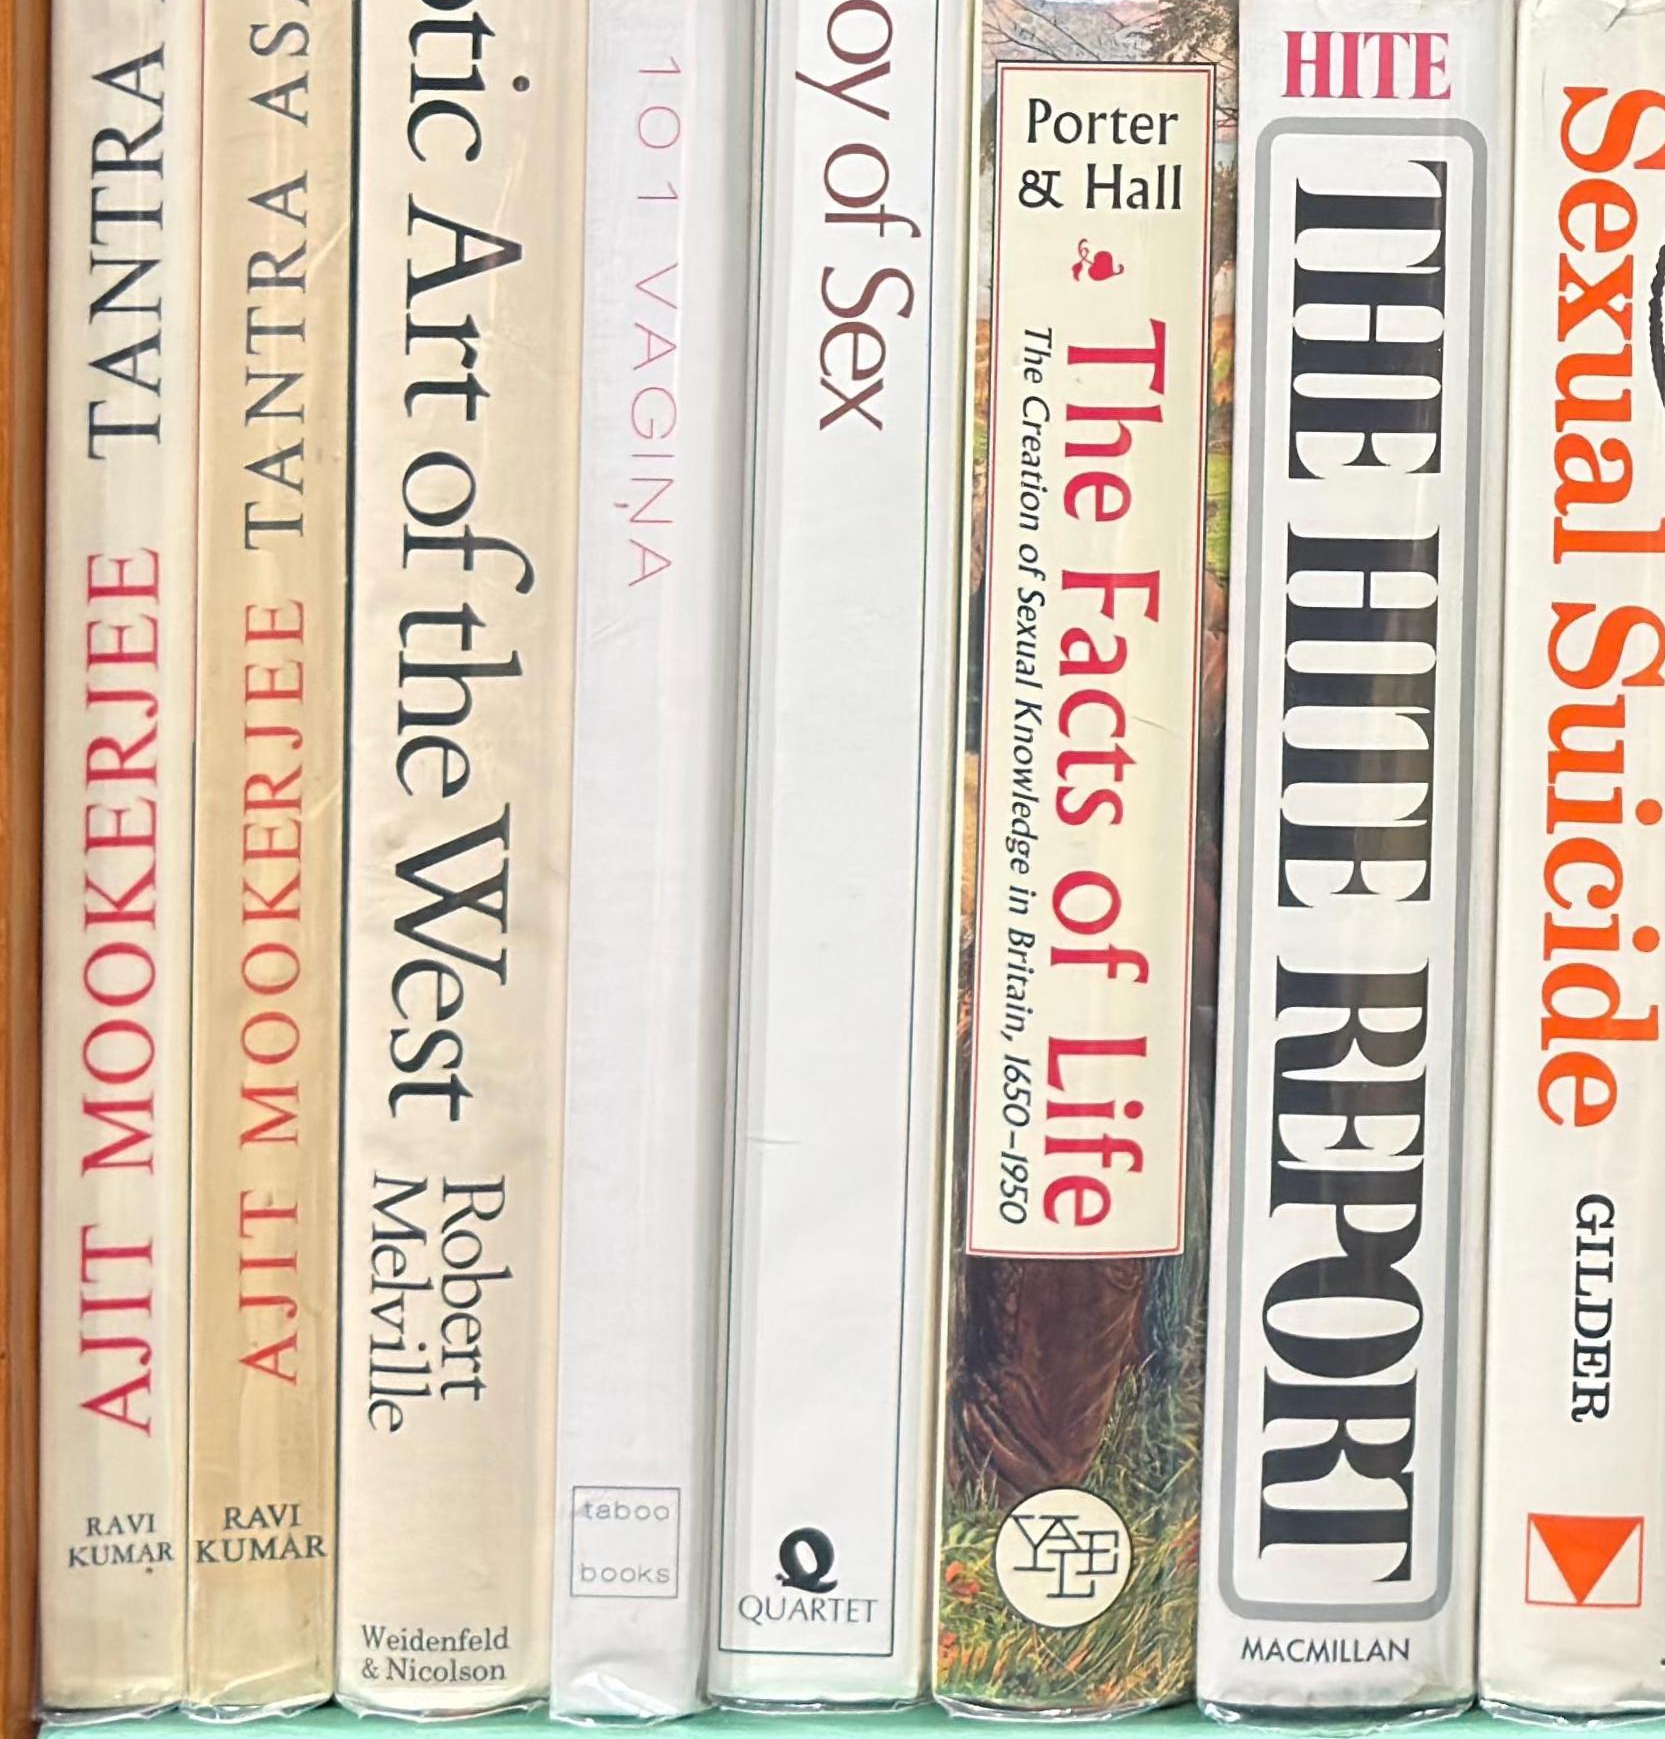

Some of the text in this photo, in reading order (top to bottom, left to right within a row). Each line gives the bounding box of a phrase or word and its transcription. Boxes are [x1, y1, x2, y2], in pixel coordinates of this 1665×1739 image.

[1026, 97, 1179, 146] Porter
[1280, 30, 1452, 100] HITE
[88, 42, 166, 459] TANTRA
[822, 142, 923, 240] of
[1018, 164, 1182, 210] & Hall
[404, 192, 523, 422] Art
[819, 265, 915, 432] Sex
[401, 450, 535, 595] of
[395, 602, 524, 798] the
[1001, 324, 1053, 1043] The Creation of Sexual Knowledge in Britain,
[1042, 317, 1167, 1228] The Facts of Life
[81, 546, 161, 1177] MOOKERJEE
[1257, 159, 1449, 1583] THE HITE REPORT
[387, 801, 513, 1123] West
[79, 1224, 154, 1438] AJIT
[366, 1175, 433, 1434] Melville
[440, 1174, 513, 1402] Robert
[1571, 1193, 1617, 1423] GILDER
[67, 1539, 174, 1568] KUMAR
[86, 1513, 156, 1538] RAVI
[579, 1563, 671, 1585] books
[581, 1502, 671, 1522] taboo
[360, 1624, 511, 1653] Weidenfeld
[361, 1657, 506, 1682] & Nicolson
[738, 1595, 879, 1626] QUARTET
[1240, 1636, 1410, 1665] MACMILLAN
